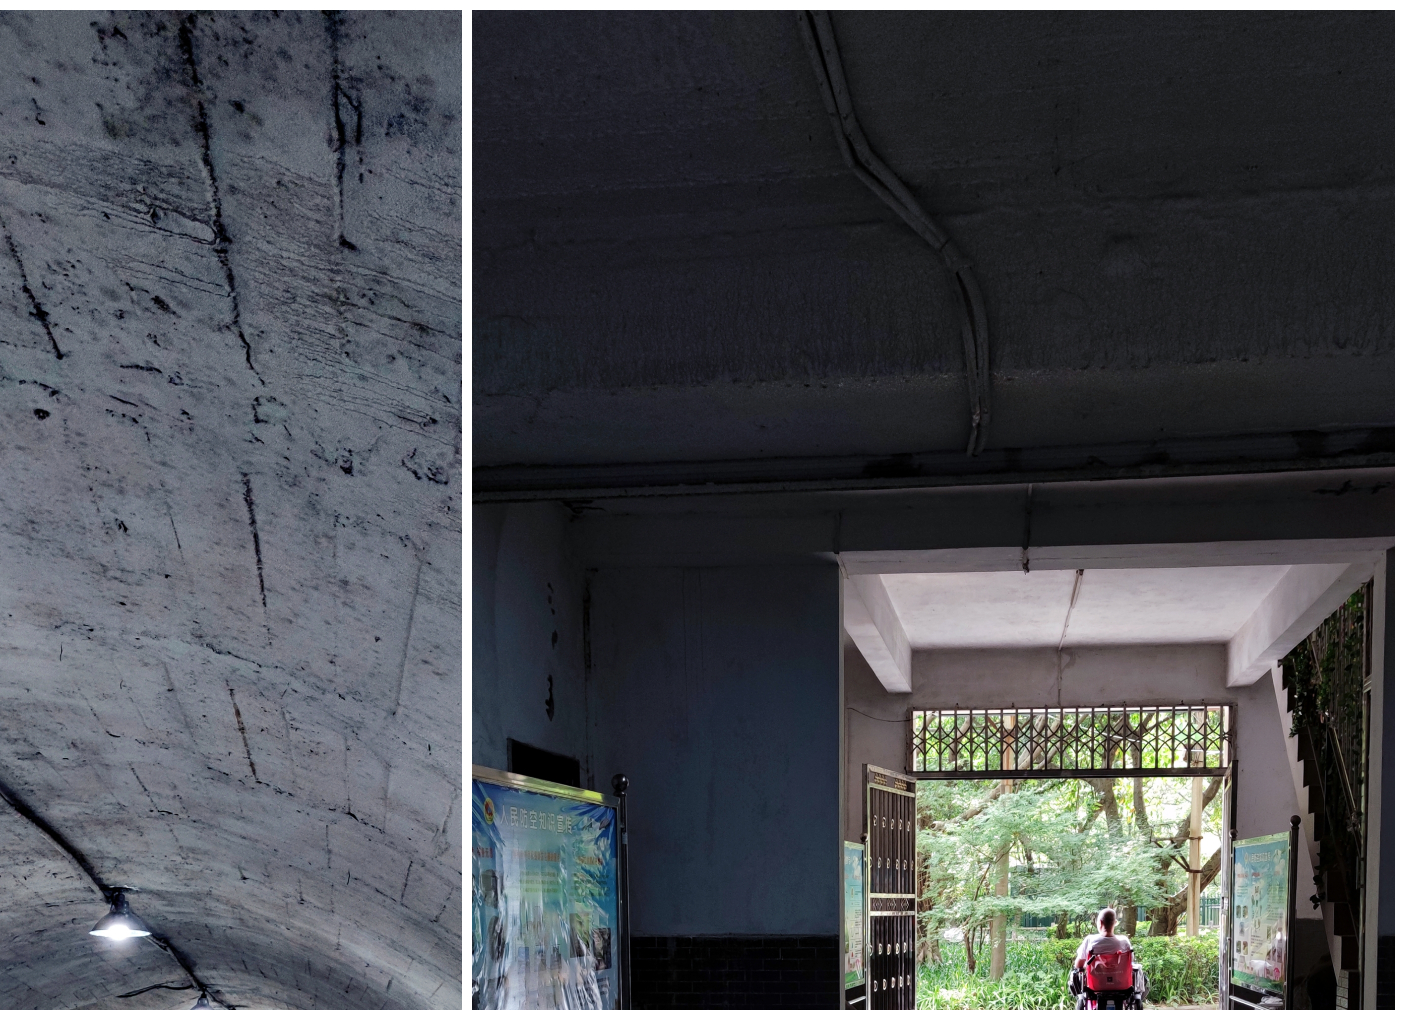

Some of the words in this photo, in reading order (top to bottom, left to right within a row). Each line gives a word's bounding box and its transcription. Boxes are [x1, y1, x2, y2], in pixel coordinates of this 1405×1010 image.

[499, 805, 573, 834] 人民防空知识宣传
